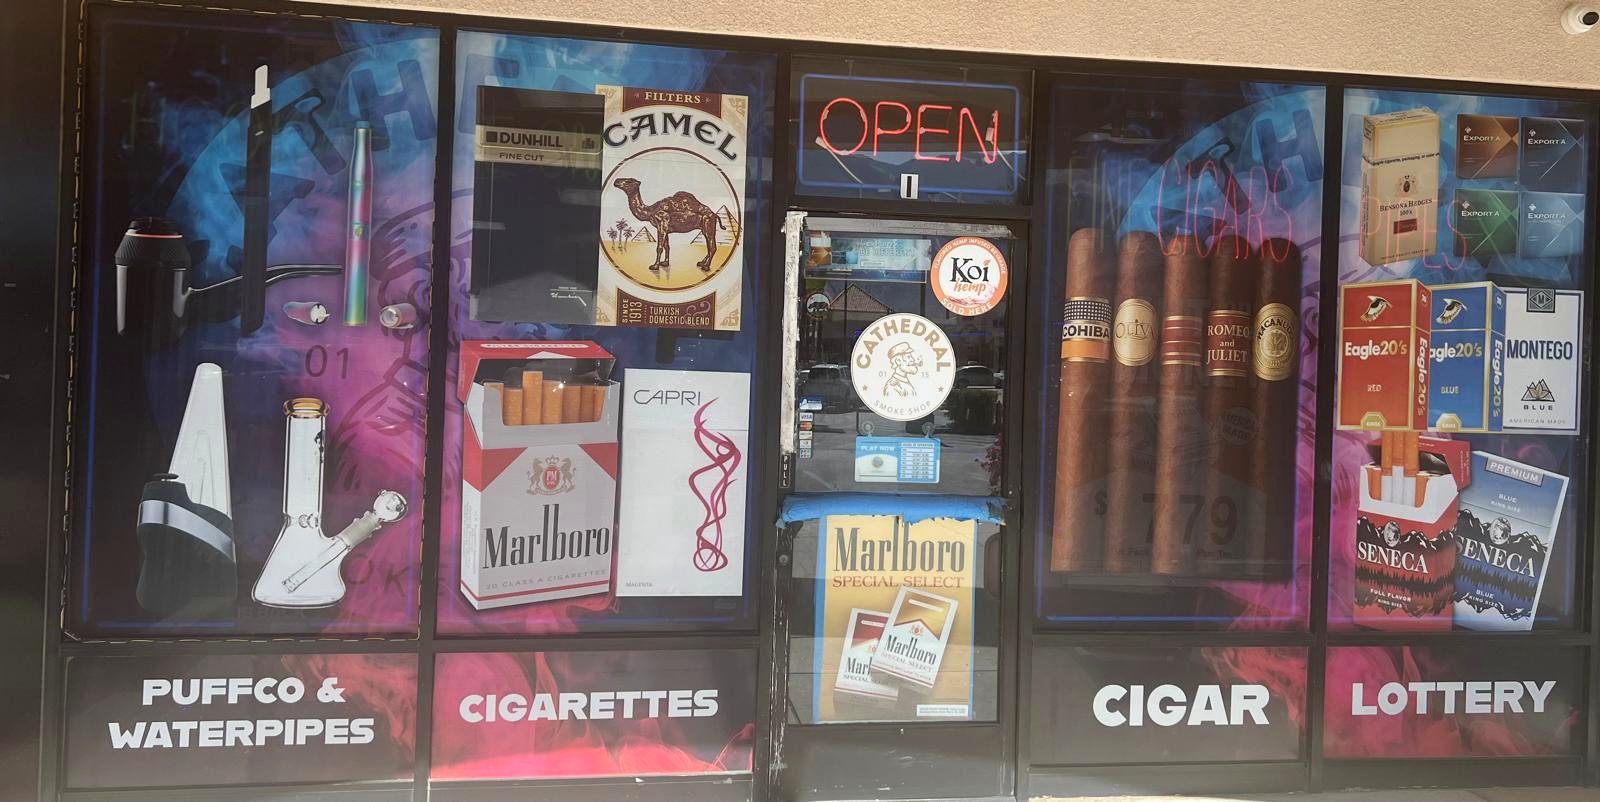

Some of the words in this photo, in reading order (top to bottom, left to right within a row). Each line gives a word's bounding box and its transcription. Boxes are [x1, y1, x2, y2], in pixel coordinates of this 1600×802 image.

[644, 91, 701, 104] FILTERS
[499, 131, 563, 148] DUNHILL
[602, 112, 738, 161] CAMEL
[819, 97, 999, 164] OPEN
[1463, 134, 1495, 142] EXPORT
[499, 152, 524, 160] FINE
[1157, 155, 1294, 263] CIGARS
[1379, 203, 1404, 212] BENSON
[1408, 198, 1432, 208] HEDGES
[950, 257, 990, 283] Koi
[954, 278, 986, 295] hemp
[630, 302, 642, 324] 1913
[941, 298, 965, 314] SOLD
[968, 302, 992, 315] HERE
[649, 316, 684, 324] DOMESTIC
[687, 316, 710, 325] BLEND
[1116, 318, 1157, 340] OLIVA
[1208, 324, 1250, 337] ROMEO
[1062, 324, 1110, 340] COHIBA
[856, 318, 951, 372] CATHEDRAL
[1220, 338, 1235, 347] and
[1344, 340, 1408, 360] Eagle20's
[1430, 342, 1482, 362] agle20's
[1506, 339, 1573, 360] MONTEGO
[306, 344, 350, 380] 01
[1206, 350, 1248, 364] JULIET
[1416, 336, 1428, 416] Eagle20's
[1492, 339, 1503, 417] Eagle20's
[633, 389, 702, 406] CAPRI
[1367, 384, 1382, 392] RED
[1440, 386, 1460, 394] BLUE
[874, 400, 905, 416] SMOKE
[908, 400, 932, 415] SHOP
[1490, 462, 1540, 482] PREMIUM
[1498, 494, 1517, 504] BLUE
[482, 503, 610, 569] Marlboro
[833, 521, 965, 573] Marlboro
[1456, 535, 1536, 578] SENECA
[1357, 541, 1429, 574] SENECA
[502, 579, 534, 587] CLASS
[546, 570, 606, 582] CIGARETTES
[832, 576, 898, 588] SPECIAL
[902, 576, 964, 588] SELECT
[1370, 588, 1385, 596] FULL
[1388, 593, 1411, 602] FLAVOR
[1476, 590, 1494, 600] BLUE
[885, 635, 936, 666] Marlboro
[846, 656, 872, 676] Marl
[881, 652, 907, 666] SPECIAL
[908, 662, 933, 673] SELECT
[842, 674, 869, 682] SPECIAL
[142, 677, 304, 706] PUFFCO
[316, 677, 347, 703] &
[1351, 680, 1557, 716] LOTTERY
[458, 689, 720, 724] CIGARETTES
[1092, 683, 1271, 728] CIGAR
[108, 717, 376, 750] WATERPIPES
